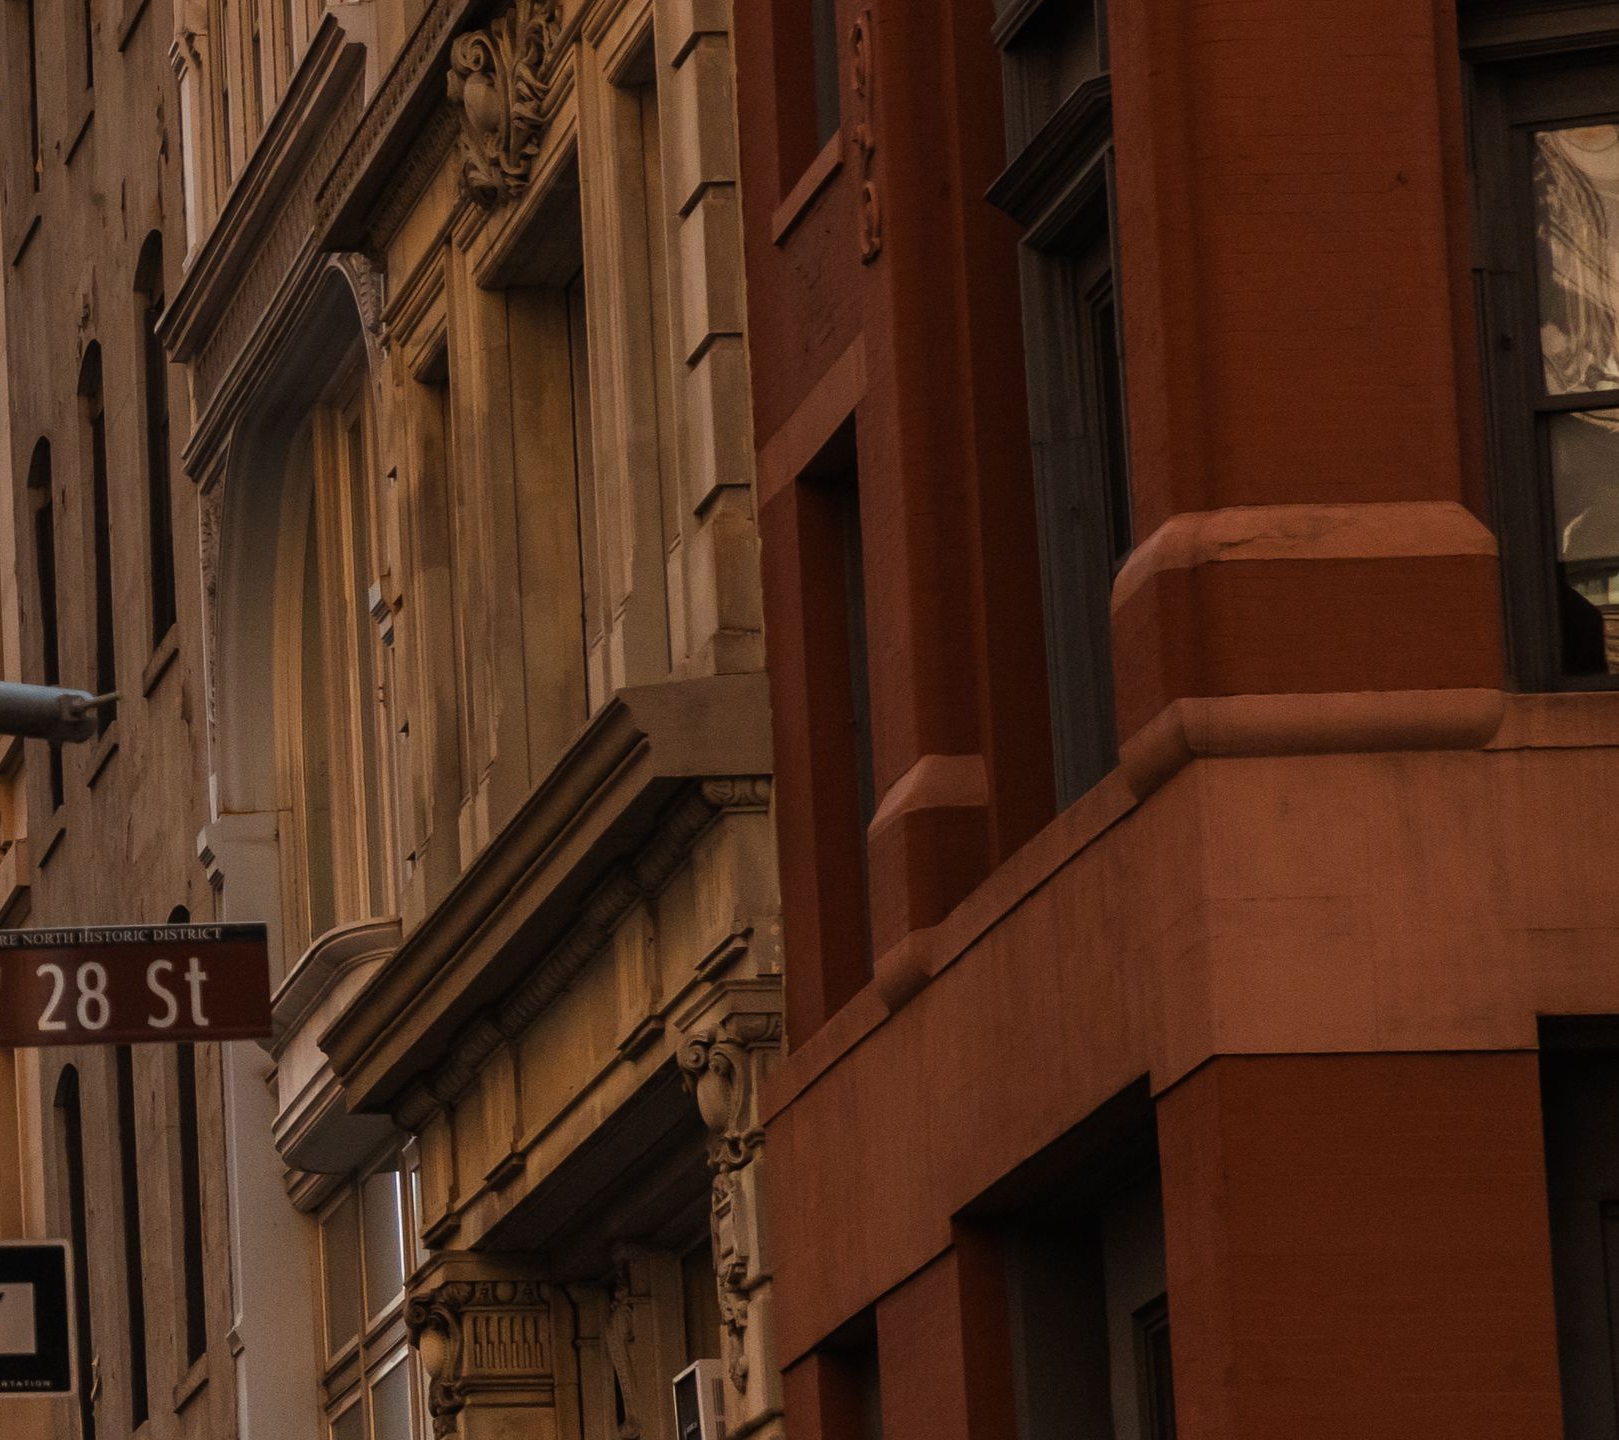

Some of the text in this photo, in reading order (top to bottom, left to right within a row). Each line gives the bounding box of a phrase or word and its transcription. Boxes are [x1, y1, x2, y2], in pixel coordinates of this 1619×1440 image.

[22, 932, 76, 945] NORTH
[78, 929, 147, 943] HISTORIC
[153, 927, 223, 940] DISTRICT
[35, 961, 110, 1031] 28
[146, 957, 210, 1029] St
